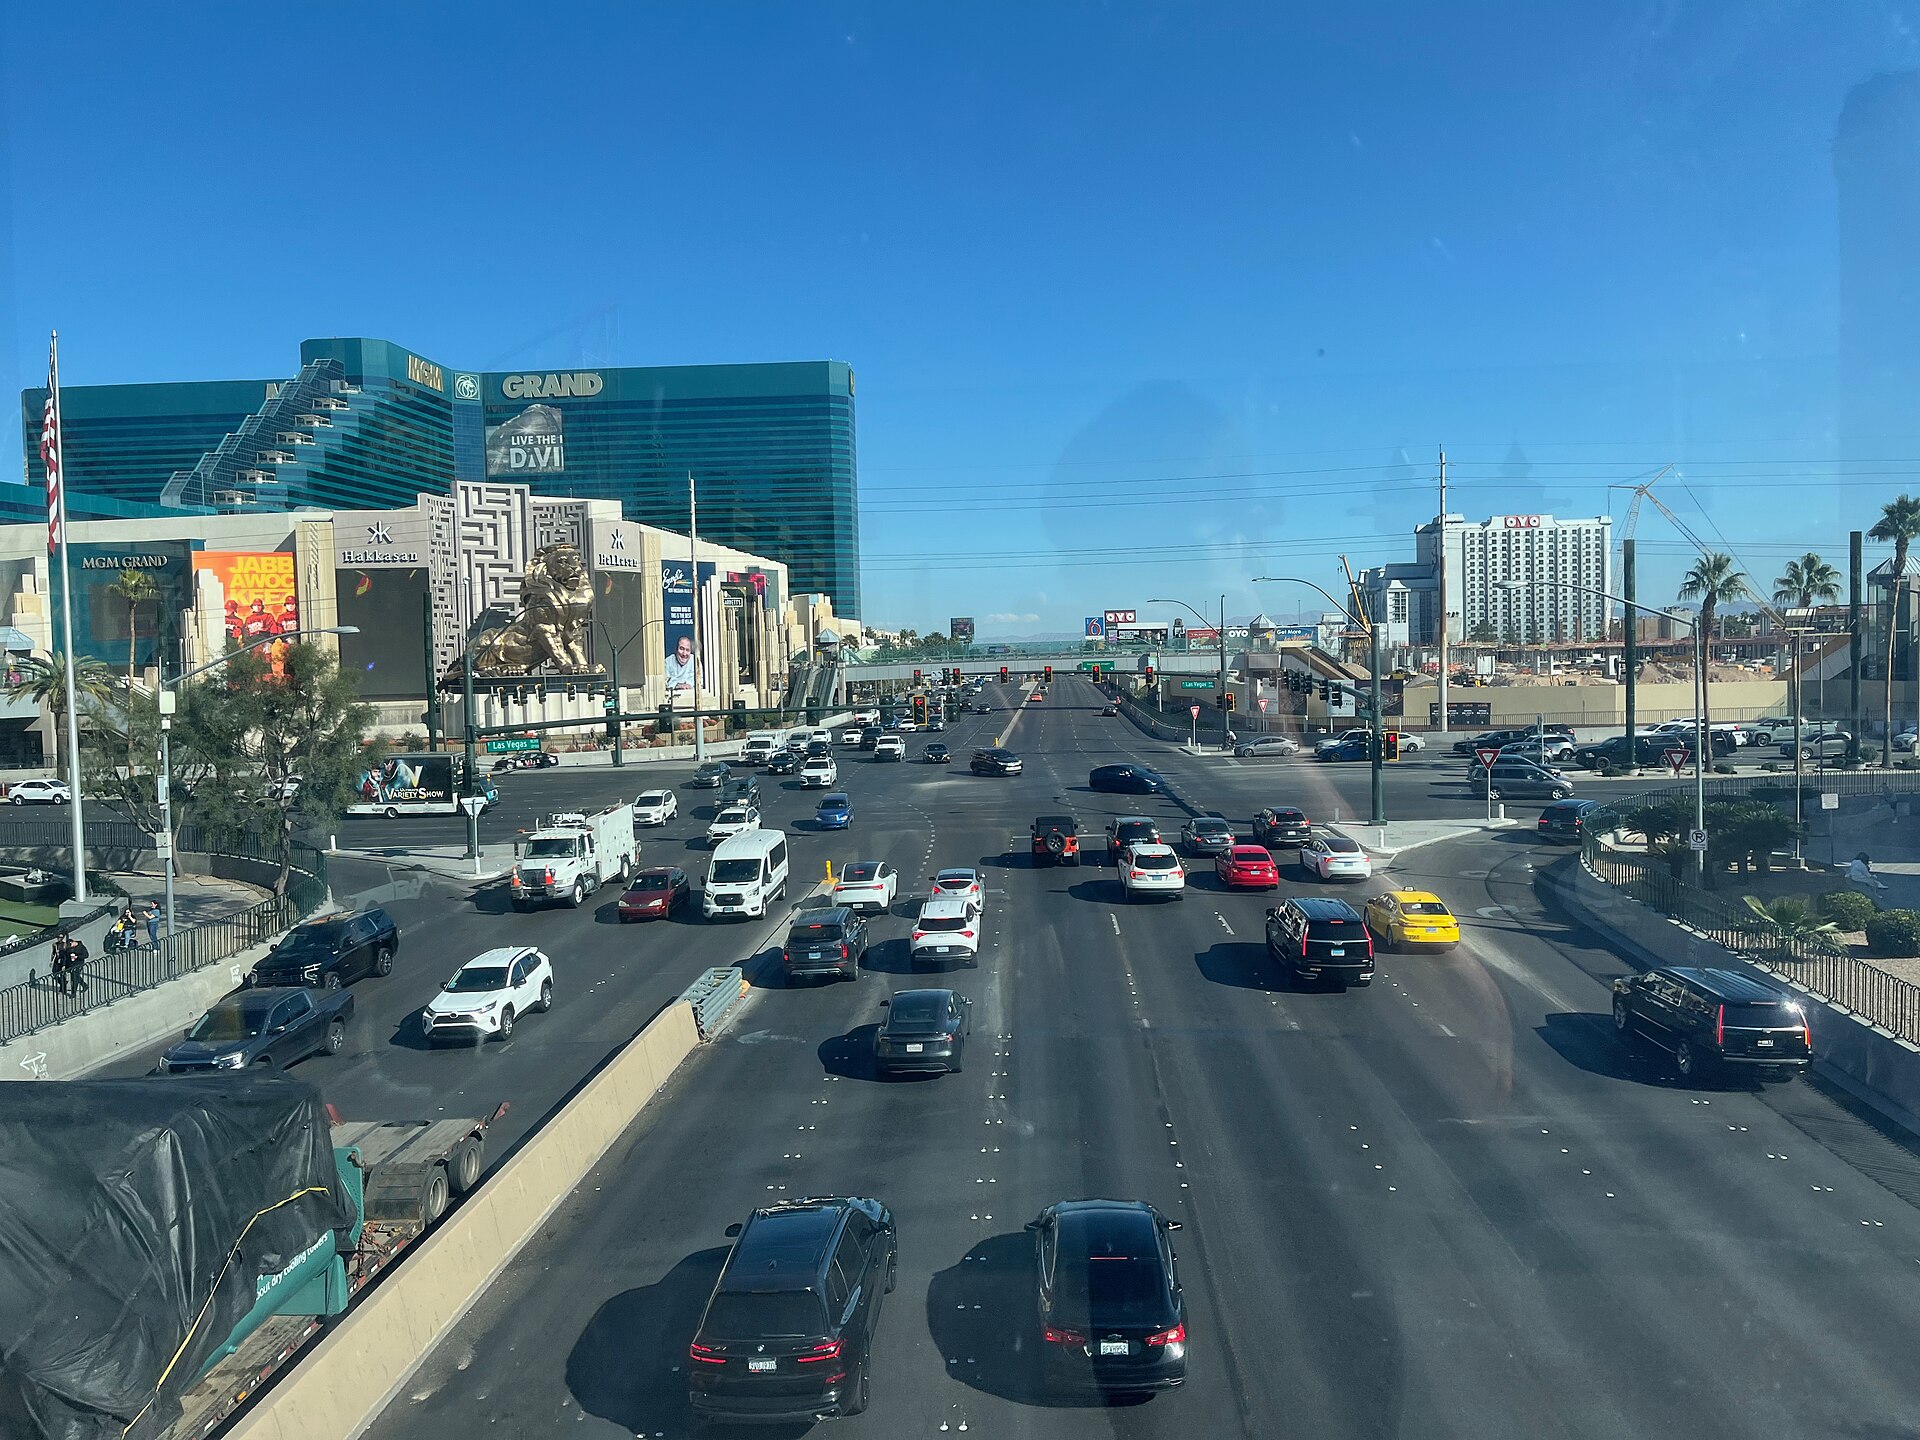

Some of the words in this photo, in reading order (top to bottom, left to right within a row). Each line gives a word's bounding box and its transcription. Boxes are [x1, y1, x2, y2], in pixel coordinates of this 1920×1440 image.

[408, 354, 443, 392] MGM
[502, 372, 602, 399] GRAND
[511, 435, 533, 446] LIVE
[536, 434, 557, 445] THE
[1506, 516, 1540, 527] OYO
[82, 556, 119, 570] MGM
[121, 555, 168, 569] GRAND
[342, 549, 418, 563] Hakkasan
[229, 556, 292, 574] JABB
[229, 573, 294, 588] AWOC
[1106, 612, 1135, 622] OYO
[1088, 617, 1102, 637] 6
[1228, 629, 1249, 638] OYO
[492, 741, 506, 750] Las
[506, 739, 528, 751] Vegas
[271, 1271, 284, 1285] dry
[283, 1250, 307, 1276] cooling
